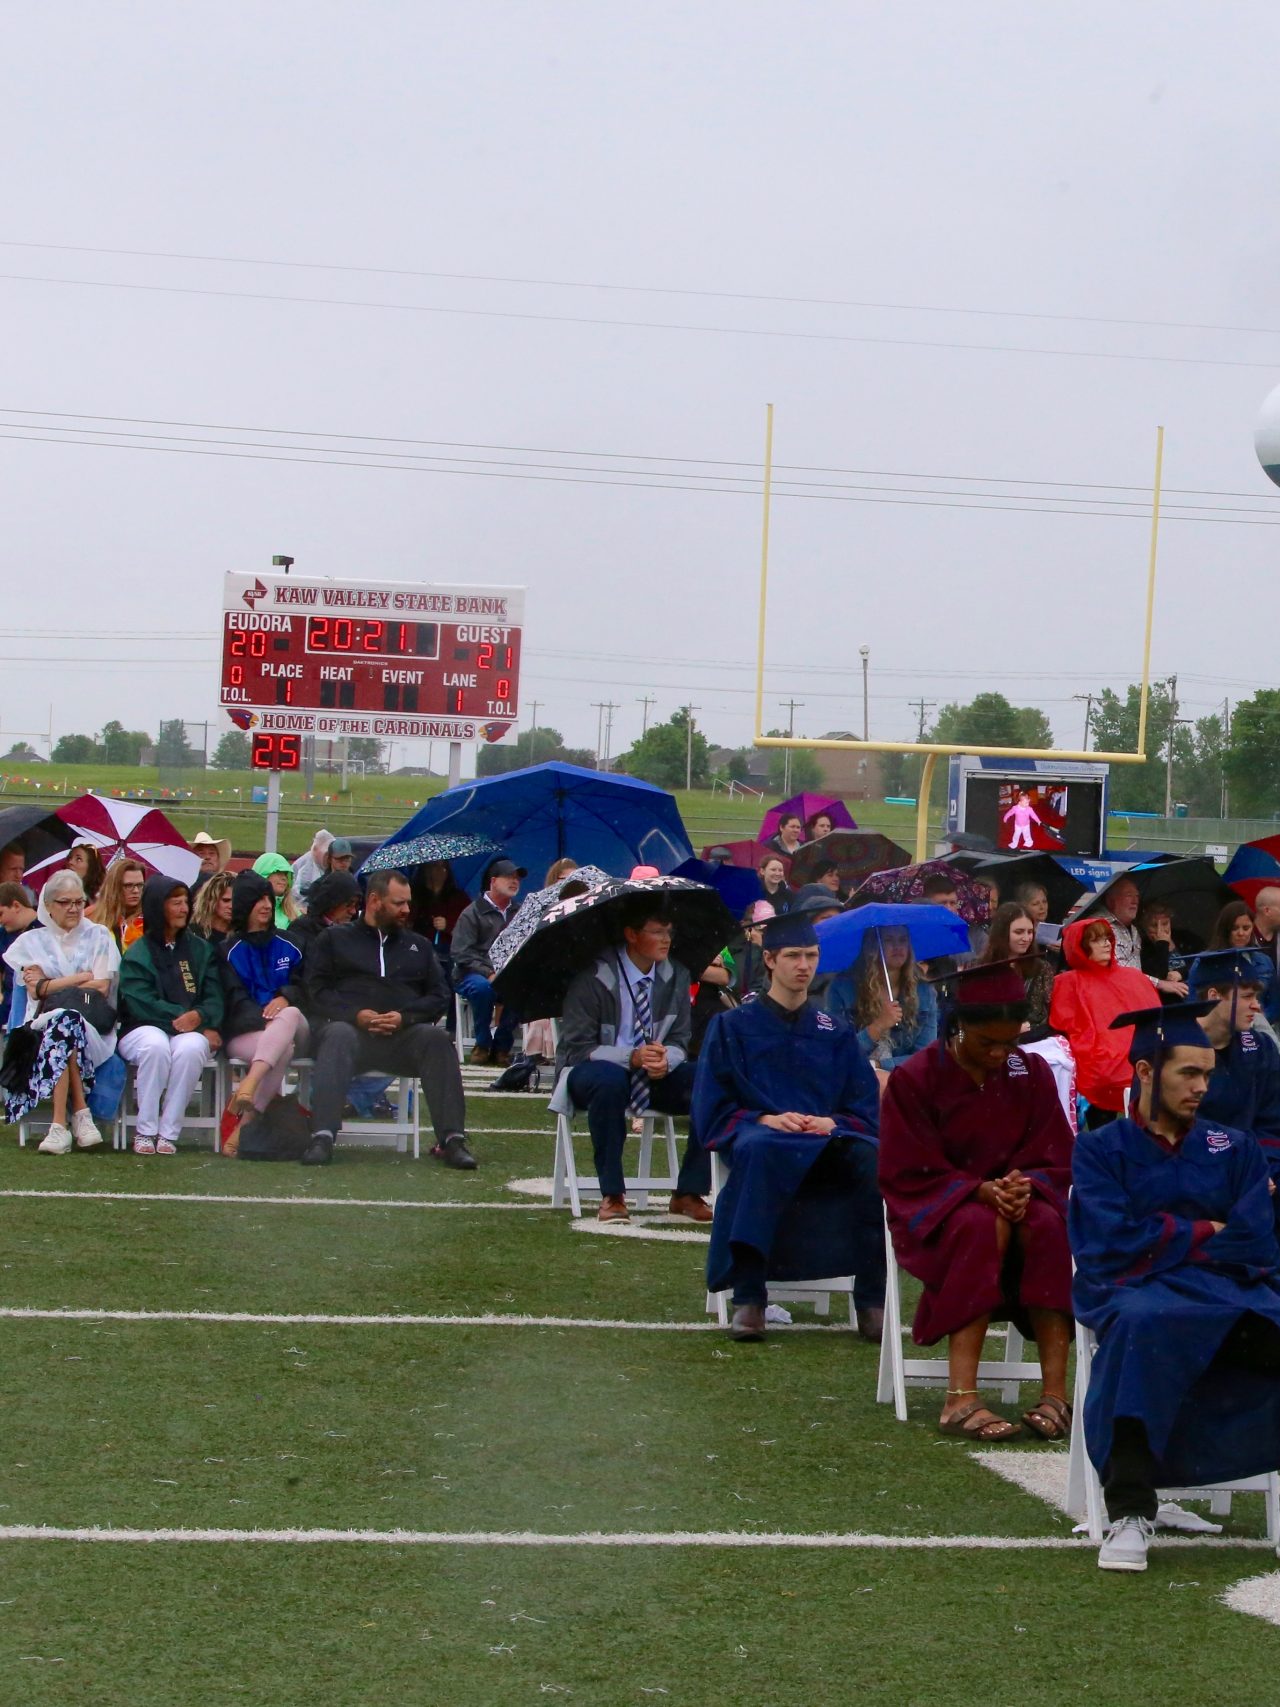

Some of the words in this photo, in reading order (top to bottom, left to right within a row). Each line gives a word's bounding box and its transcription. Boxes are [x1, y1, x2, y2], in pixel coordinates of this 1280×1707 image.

[274, 586, 319, 605] KAW
[322, 588, 391, 609] VALLEY
[394, 592, 453, 613] STATE
[455, 595, 507, 615] BANK
[228, 613, 292, 632] EUDORA
[231, 631, 266, 657] 20
[456, 625, 512, 644] GUEST
[477, 643, 513, 669] 21
[231, 665, 242, 684] 0
[261, 663, 303, 678] PLACE
[320, 666, 354, 681] HEAT
[382, 669, 424, 685] EVENT
[443, 672, 477, 688] LANE
[221, 687, 252, 702] T.O.L.
[286, 680, 292, 703] 1
[497, 679, 509, 699] 0
[457, 689, 463, 712] 1
[486, 700, 516, 716] T.O.L.
[261, 712, 316, 731] HOME
[318, 718, 337, 734] OF
[339, 719, 370, 736] THE
[372, 718, 476, 740] CARDINALS
[255, 735, 297, 767] 25
[1070, 867, 1086, 876] LED
[1088, 868, 1110, 879] signs
